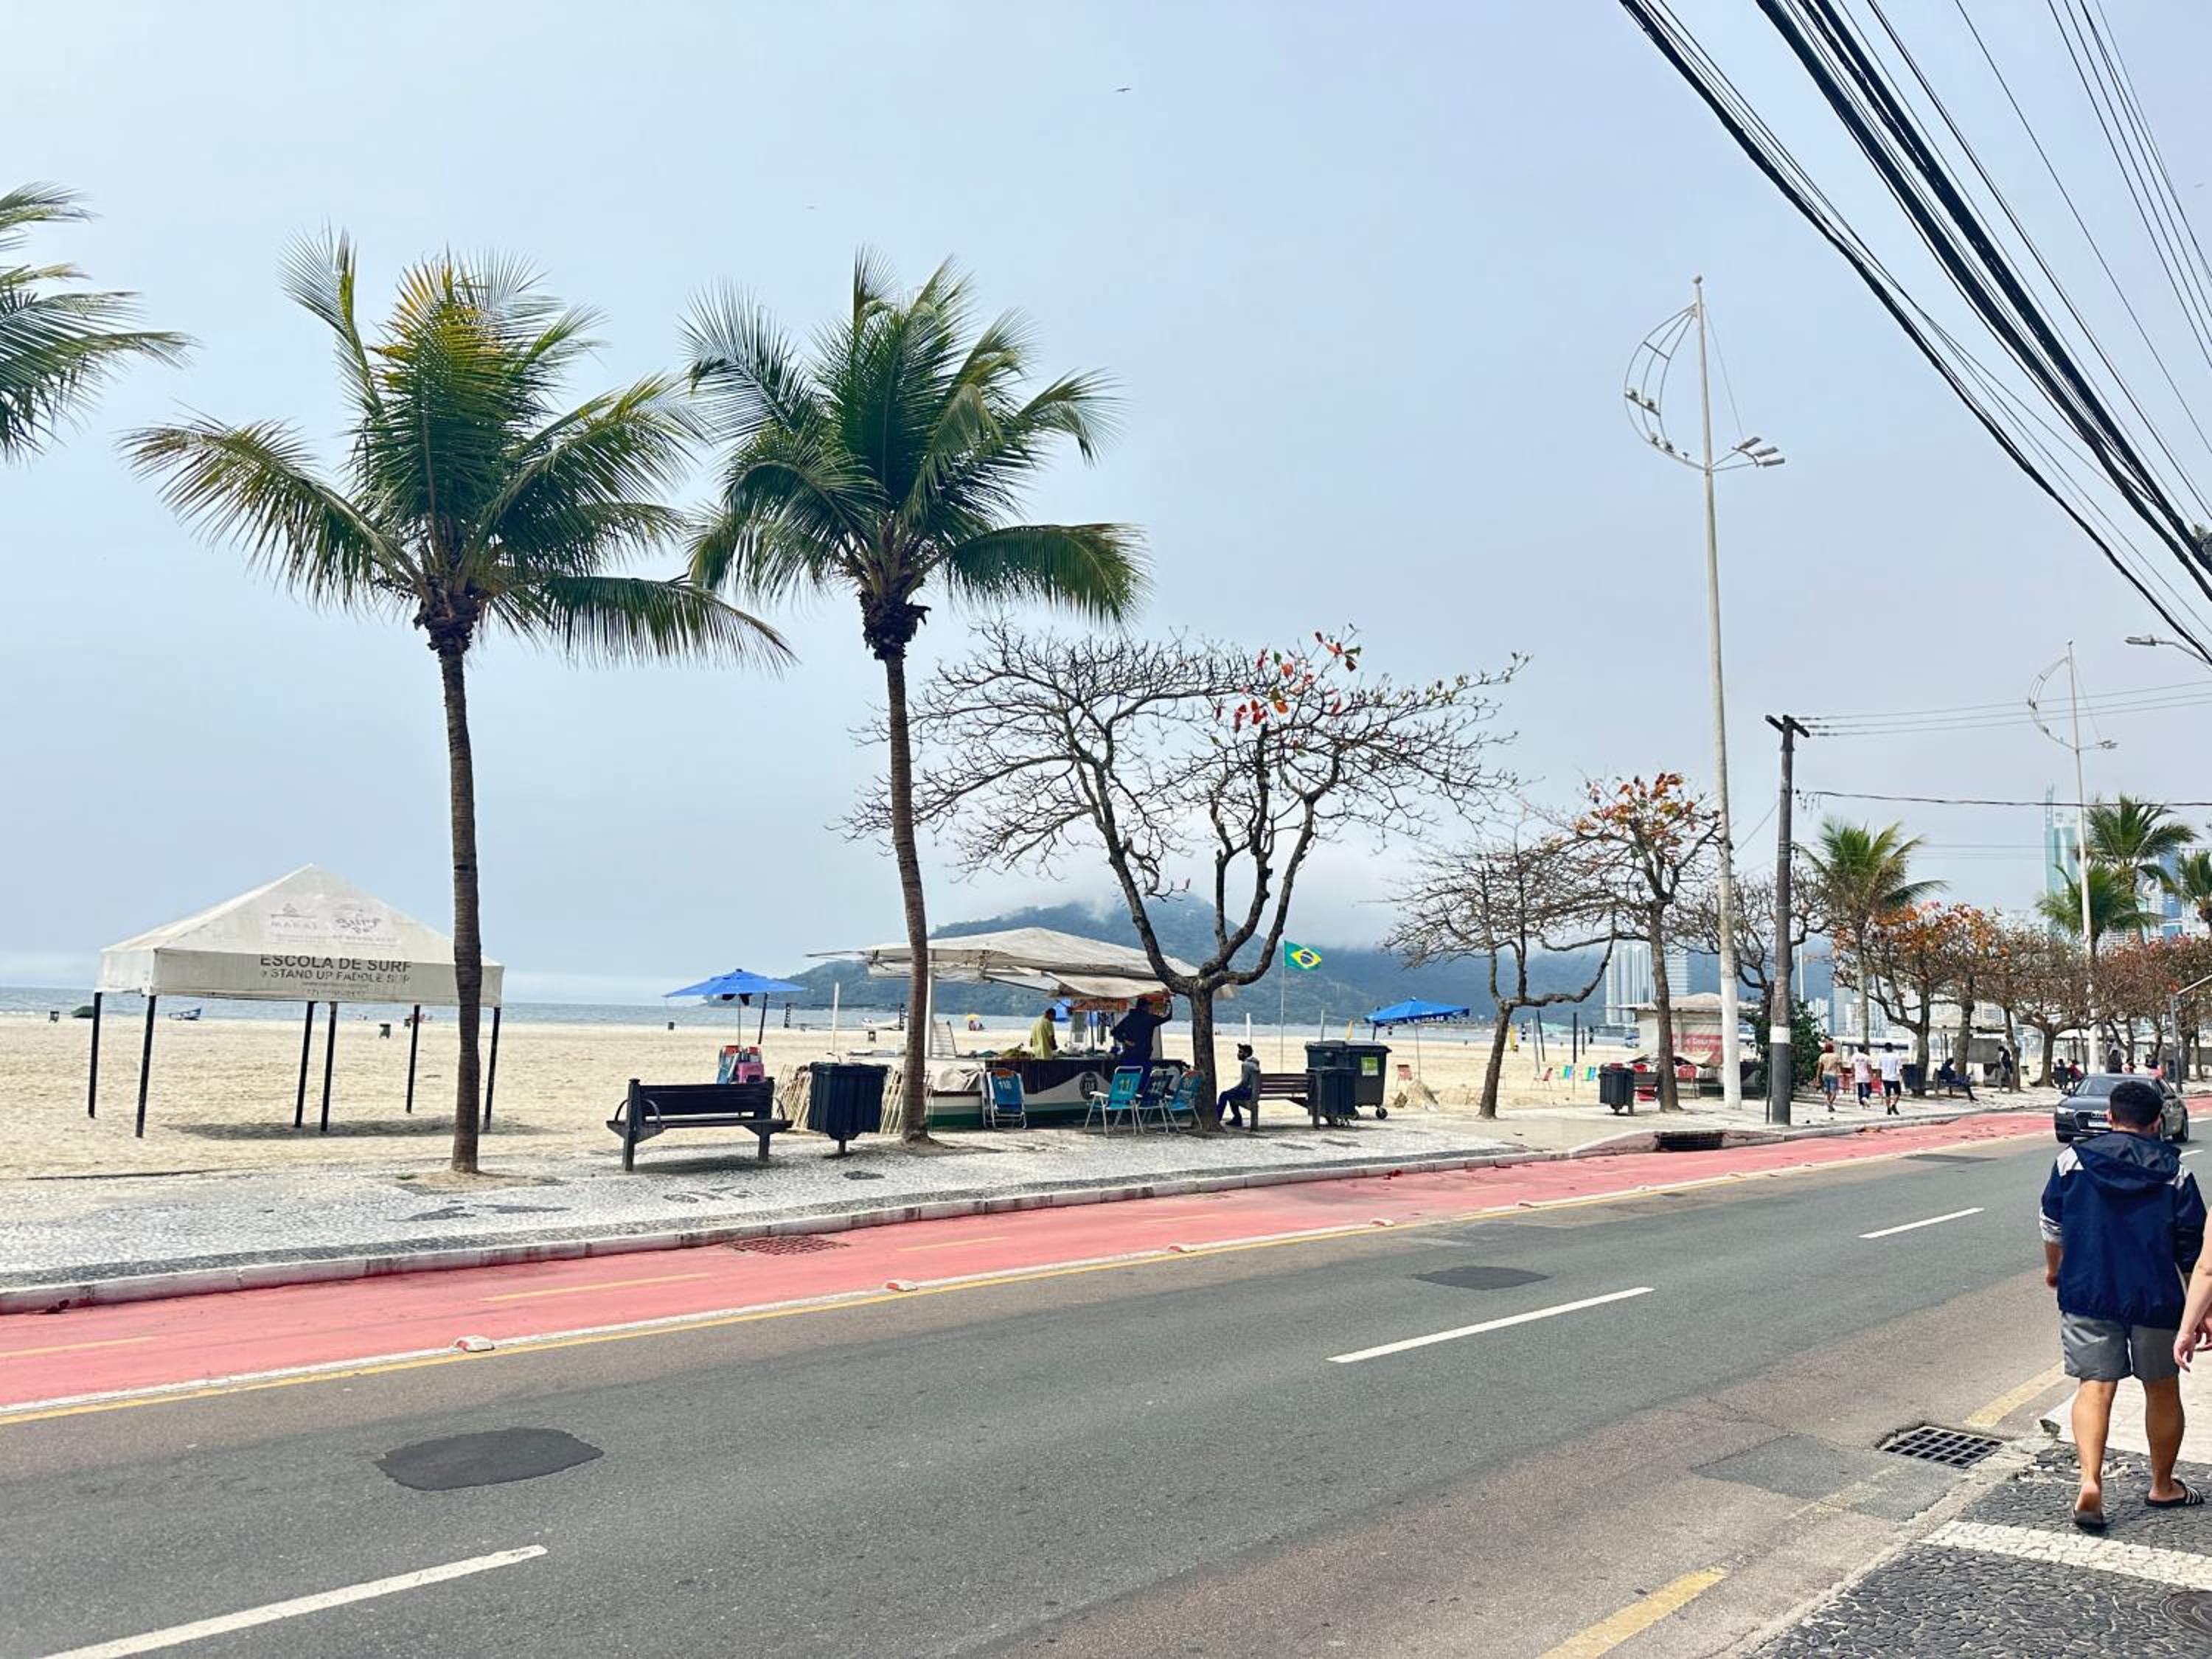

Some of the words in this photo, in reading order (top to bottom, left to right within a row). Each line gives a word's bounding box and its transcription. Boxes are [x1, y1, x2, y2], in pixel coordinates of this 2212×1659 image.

[260, 955, 333, 969] ESCOLA
[338, 958, 361, 970] DE
[367, 959, 412, 973] SURF
[271, 969, 313, 979] STAND
[316, 971, 333, 980] UP
[386, 974, 410, 984] SP
